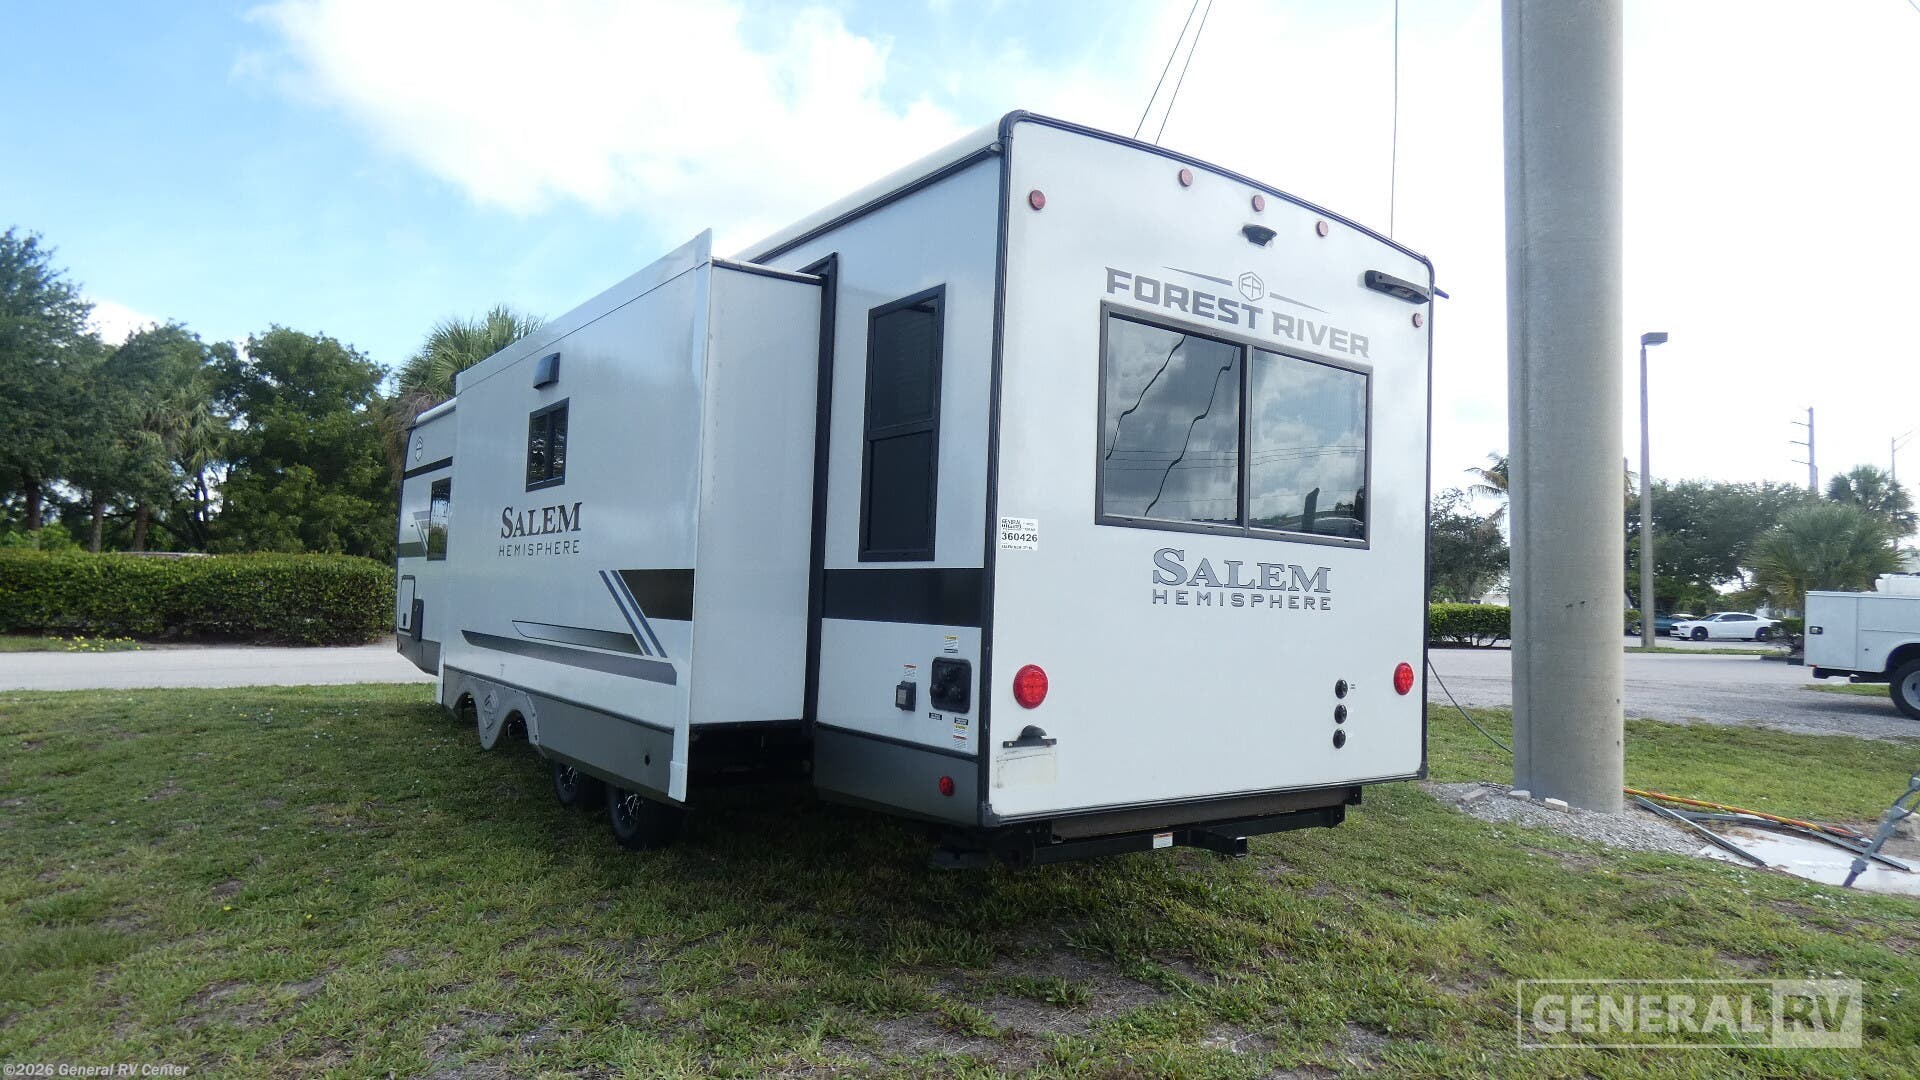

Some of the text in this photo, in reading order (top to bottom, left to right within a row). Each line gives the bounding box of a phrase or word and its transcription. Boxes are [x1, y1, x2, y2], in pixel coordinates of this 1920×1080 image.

[1105, 266, 1370, 358] FOREST RIVER
[500, 502, 582, 539] SALEM
[499, 540, 580, 557] HEMISPHERE
[1001, 532, 1038, 542] 360426
[1152, 547, 1331, 593] SALEM
[1152, 589, 1331, 611] HEMISPHERE
